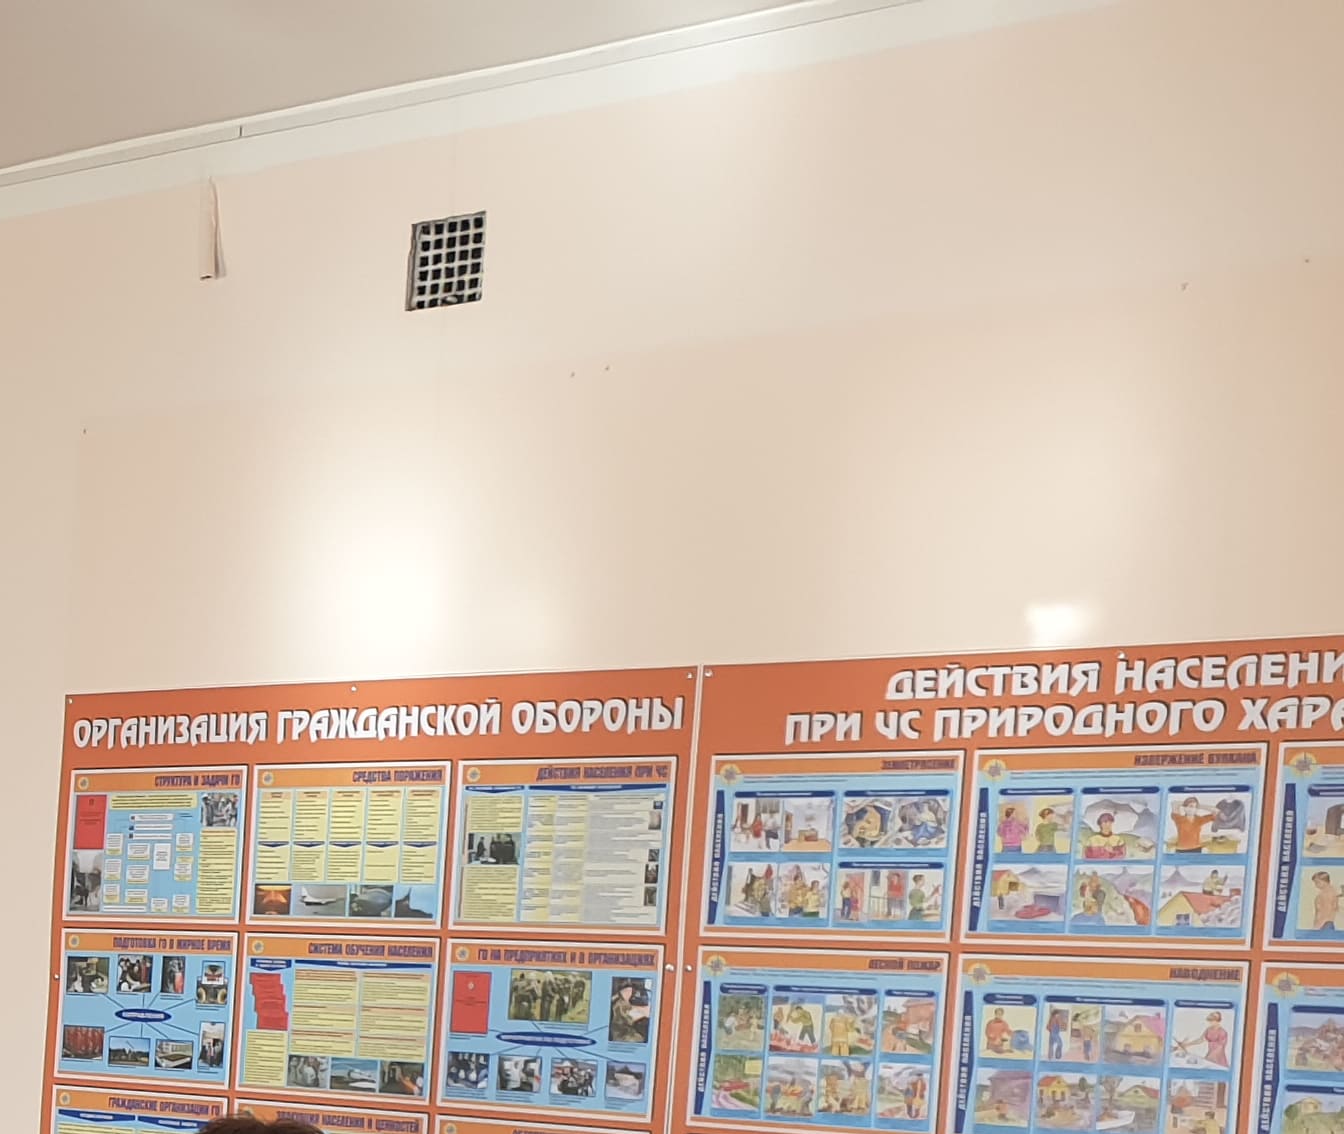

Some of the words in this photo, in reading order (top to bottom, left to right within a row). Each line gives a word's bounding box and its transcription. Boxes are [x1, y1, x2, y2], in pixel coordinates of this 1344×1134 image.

[885, 661, 1100, 700] ДЕЙСТВИЯ
[73, 711, 267, 750] ОРГАНИЗАЦИЯ
[277, 698, 502, 744] ГРАЖДАНСКОЙ
[512, 696, 685, 735] ОБОРОНЫ
[785, 711, 862, 746] ПРИ
[875, 709, 921, 740] ЧС
[933, 699, 1226, 743] ПРИРОДНОГО
[352, 769, 391, 784] СРЕДСТВА
[394, 768, 442, 782] ПОРАЖЕНИЯ
[308, 942, 343, 955] СИСТЕМА
[1169, 967, 1241, 981] НАВОДНЕНИЕ
